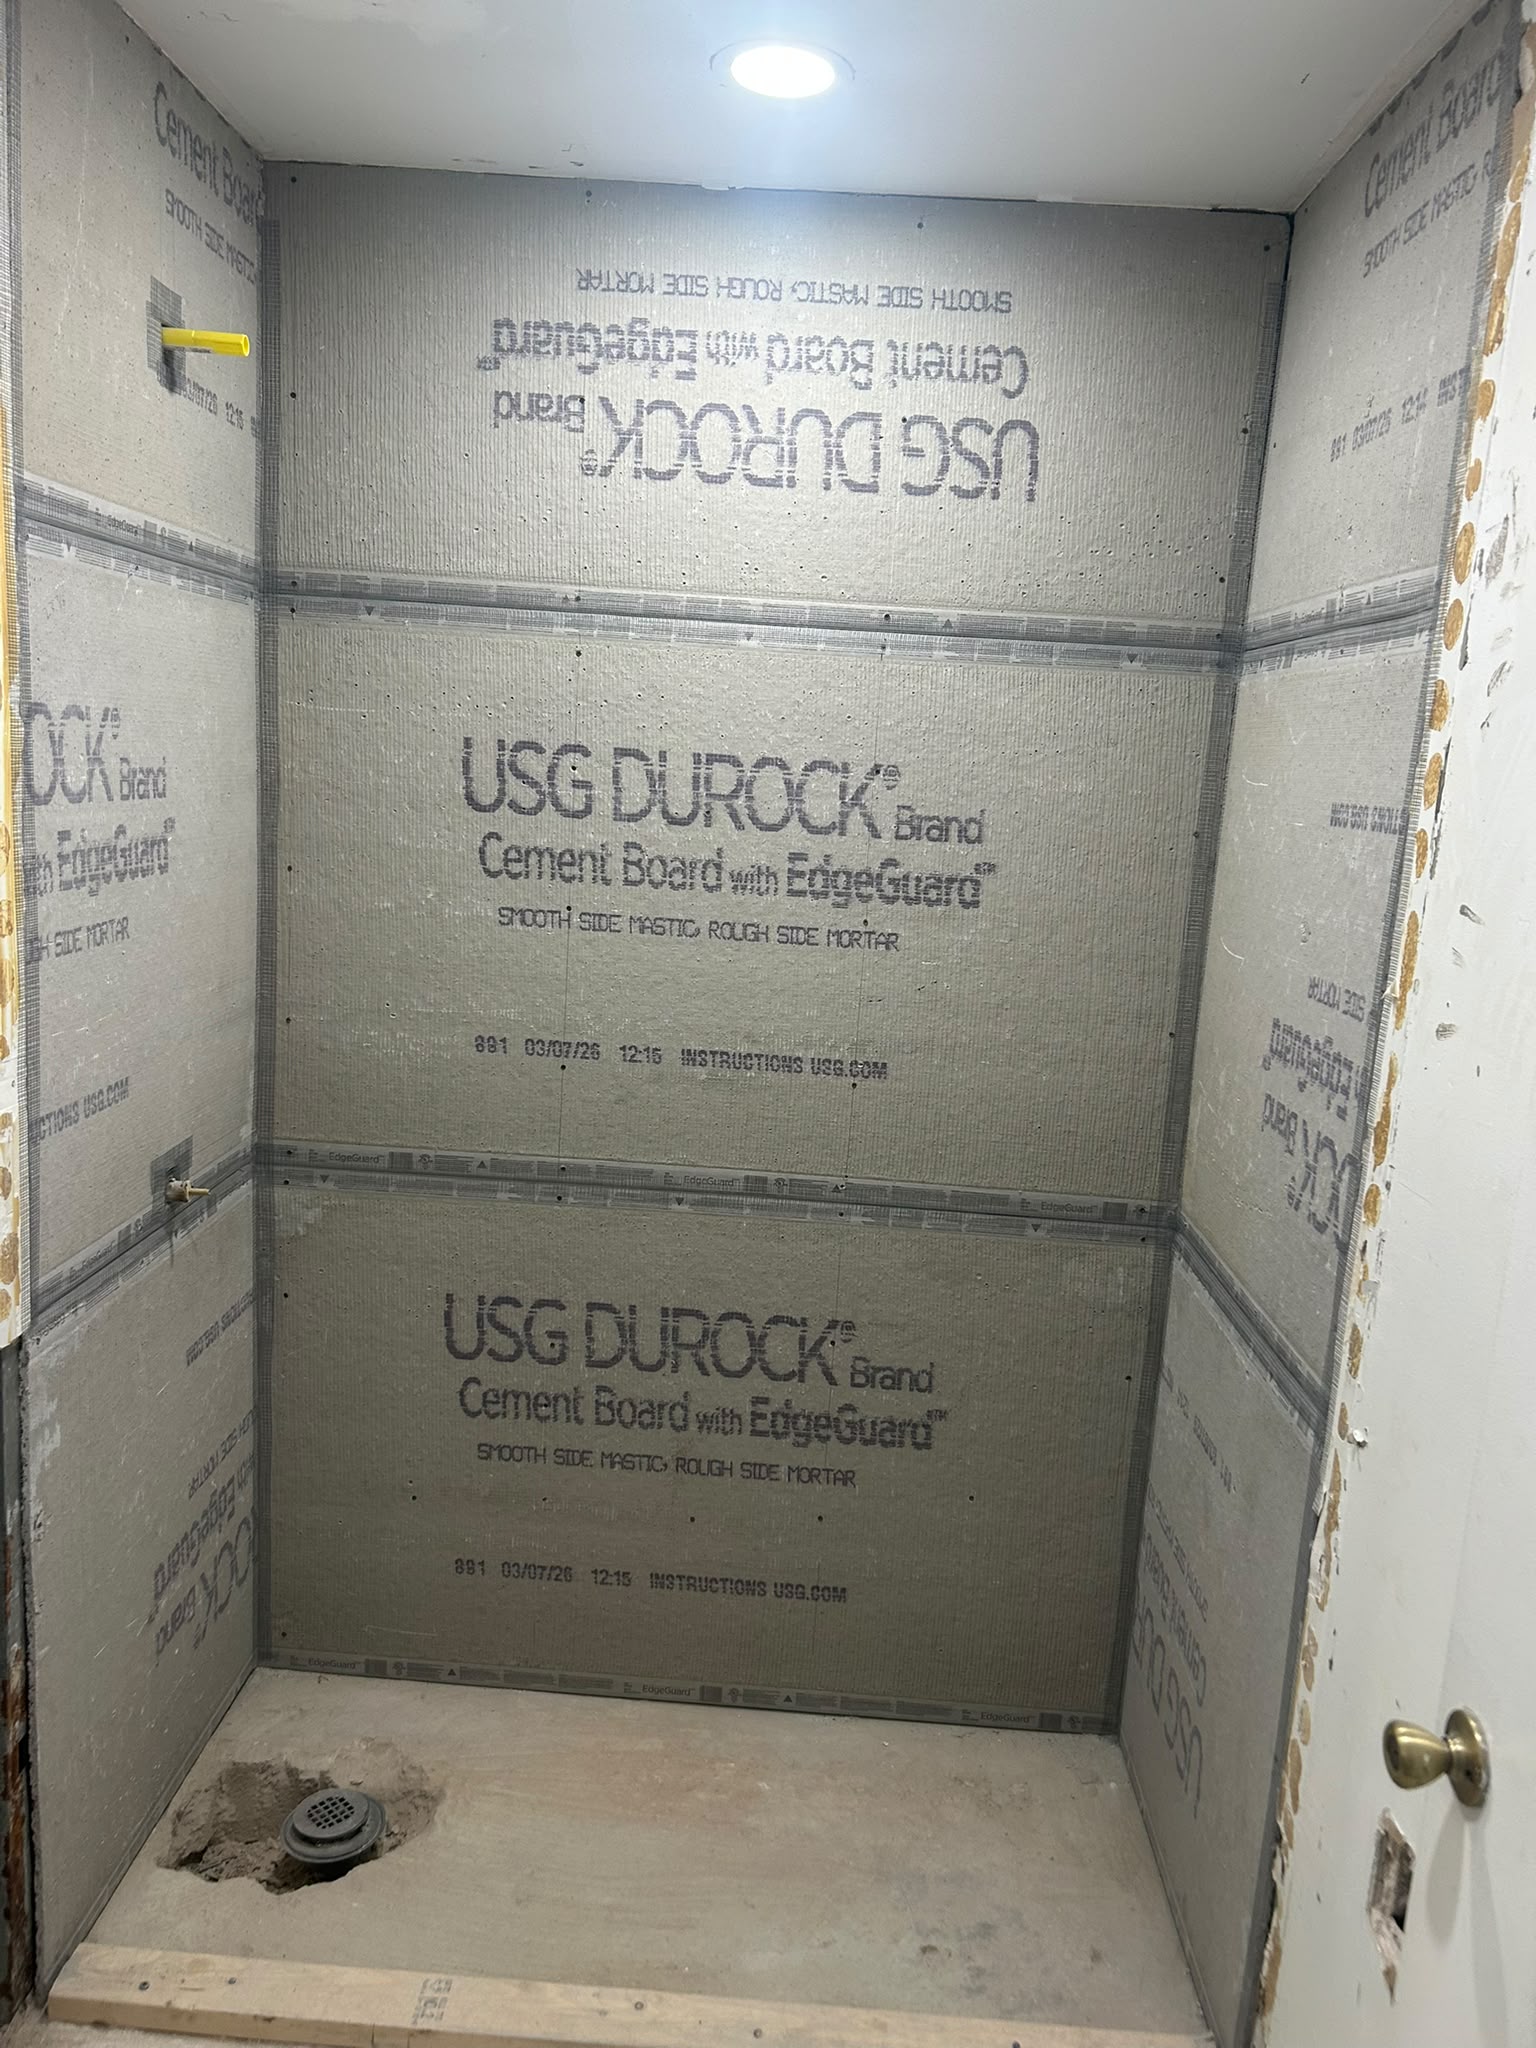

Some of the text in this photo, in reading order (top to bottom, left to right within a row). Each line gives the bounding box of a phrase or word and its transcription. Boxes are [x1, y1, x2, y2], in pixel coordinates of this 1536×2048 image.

[154, 81, 219, 197] Cement
[1365, 100, 1433, 218] Cement
[1403, 201, 1430, 245] SIDE
[576, 267, 656, 293] MORTAR
[663, 273, 709, 297] SIDE
[716, 278, 783, 302] ROUGH
[877, 286, 925, 309] SIDE
[931, 290, 1013, 314] SMOOTH
[705, 329, 760, 367] with
[767, 332, 874, 390] Board
[886, 338, 1029, 399] Cement
[493, 390, 586, 434] Brand
[901, 414, 1040, 503] USG
[119, 756, 167, 801] Brand
[462, 737, 594, 820] USG
[894, 804, 986, 845] Brand
[479, 832, 613, 888] Cement
[621, 841, 725, 895] Board
[728, 863, 780, 898] with
[54, 924, 83, 958] SIDE
[86, 916, 130, 950] MORTAR
[498, 906, 572, 930] SMOOTH
[579, 910, 623, 934] SIDE
[708, 920, 770, 944] ROUGH
[776, 923, 820, 947] SIDE
[826, 927, 900, 952] MORTAR
[1344, 988, 1366, 1022] SIDE
[524, 1040, 601, 1061] 03/07/26
[618, 1044, 663, 1065] 12:15
[680, 1048, 804, 1075] INSTRUCTIONS
[809, 1056, 888, 1080] USG.COM
[83, 1076, 129, 1119] USG.COM
[1261, 1092, 1299, 1157] Brand
[443, 1293, 568, 1366] USG
[850, 1356, 935, 1395] Brand
[458, 1376, 585, 1427] Cement
[593, 1384, 690, 1434] Board
[694, 1406, 743, 1438] with
[477, 1442, 548, 1466] SMOOTH
[553, 1446, 594, 1469] SIDE
[675, 1455, 734, 1480] ROUGH
[740, 1460, 781, 1484] SIDE
[786, 1464, 857, 1489] MORTAR
[500, 1560, 574, 1583] 03/07/26
[591, 1567, 633, 1588] 12:15
[649, 1571, 768, 1598] INSTRUCTIONS
[773, 1581, 848, 1604] USG.COM
[155, 1583, 197, 1667] Brand
[1163, 1666, 1203, 1820] USG
